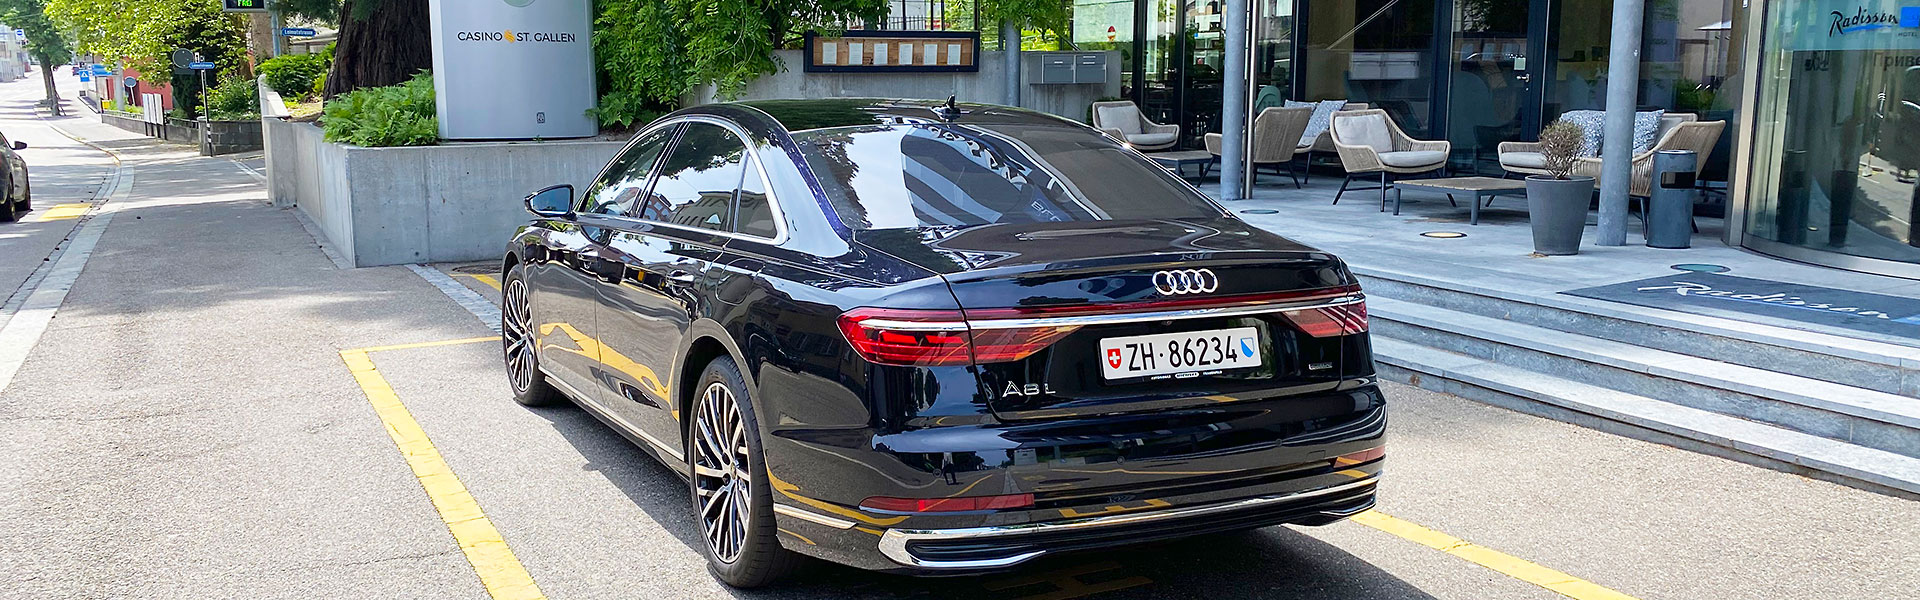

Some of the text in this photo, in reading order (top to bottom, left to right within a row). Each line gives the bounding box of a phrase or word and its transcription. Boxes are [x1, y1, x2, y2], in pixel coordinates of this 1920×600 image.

[457, 31, 576, 43] CASINO ST. GALLEN
[1829, 5, 1898, 38] Radisson
[1637, 281, 1889, 319] Radisson
